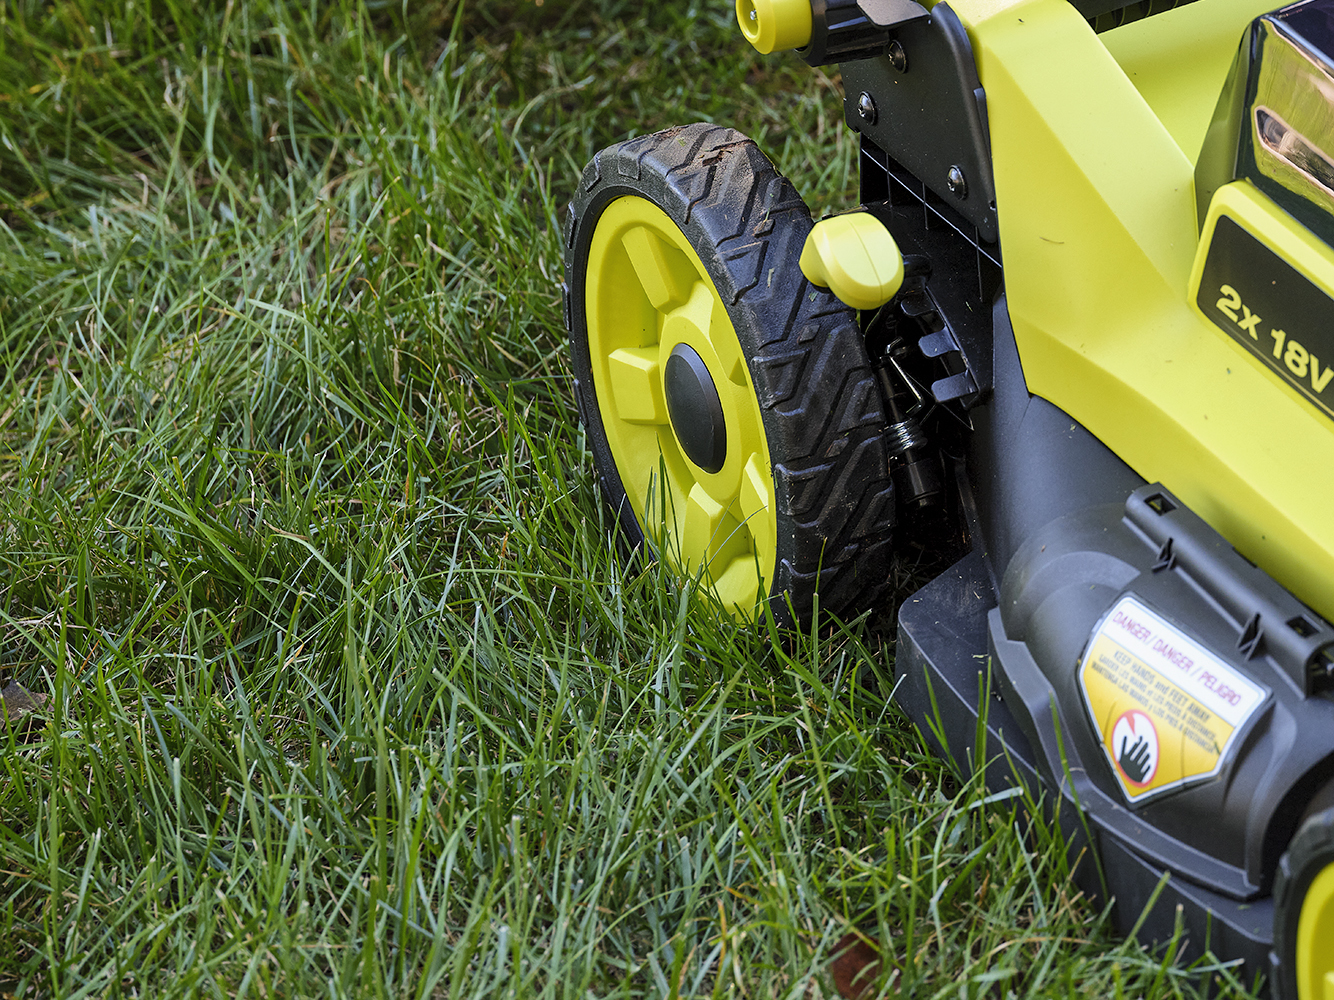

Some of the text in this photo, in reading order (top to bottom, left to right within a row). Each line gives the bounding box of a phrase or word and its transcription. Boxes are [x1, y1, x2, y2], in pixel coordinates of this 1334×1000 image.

[1112, 611, 1151, 644] DANGER
[1152, 638, 1194, 676] DANGER
[1199, 670, 1242, 707] PELIGRO
